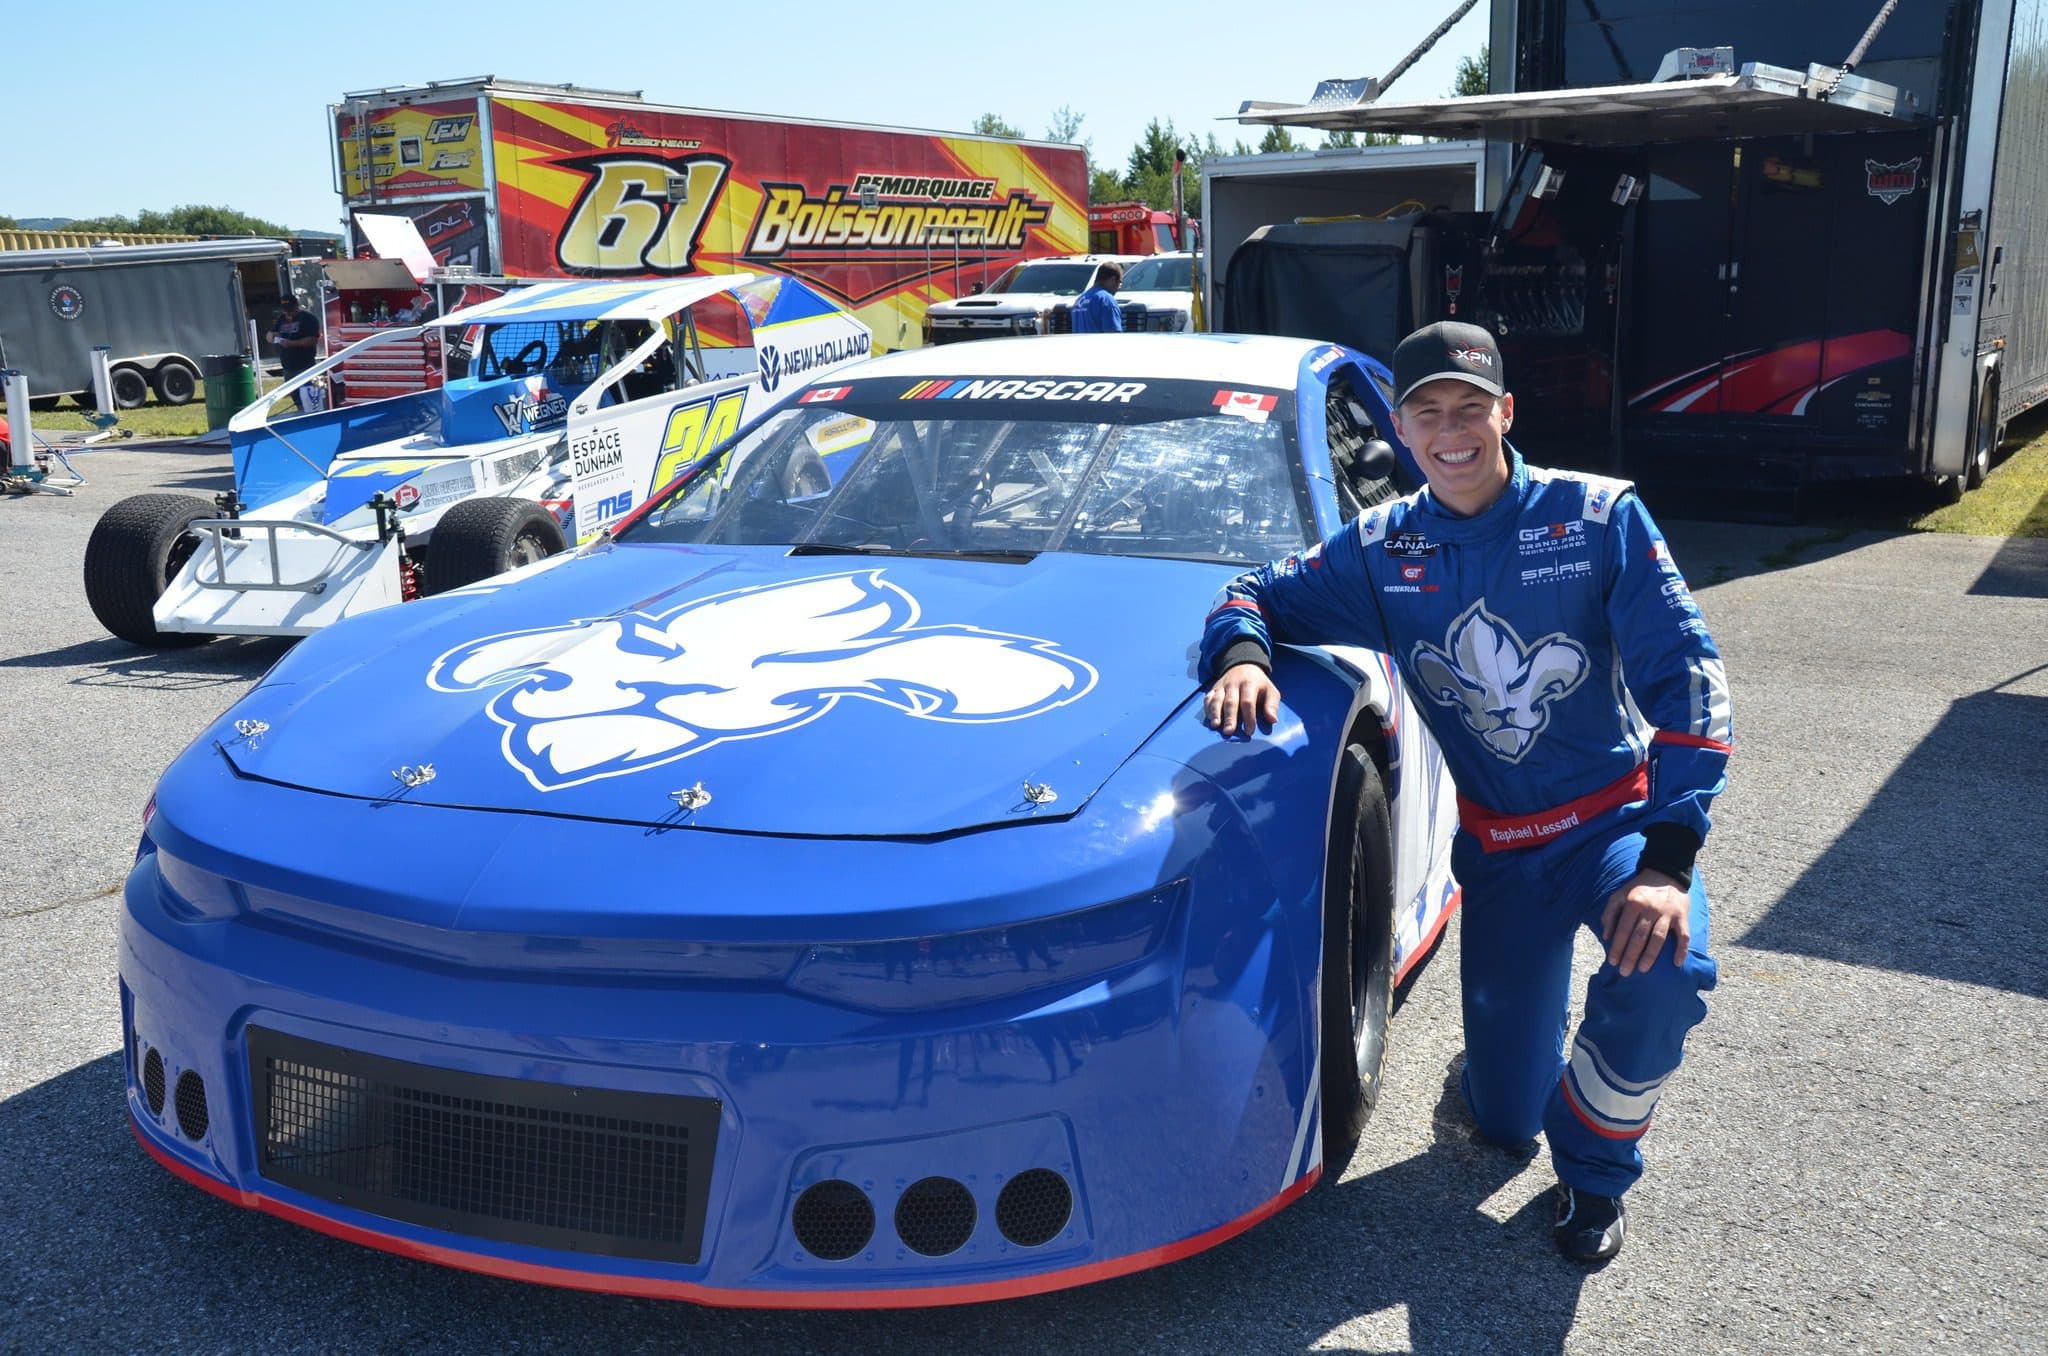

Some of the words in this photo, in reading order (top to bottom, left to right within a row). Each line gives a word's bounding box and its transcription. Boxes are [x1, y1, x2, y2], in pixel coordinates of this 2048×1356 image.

[560, 158, 728, 270] 61
[749, 186, 1046, 254] Boissonneault
[783, 349, 814, 377] NEW
[814, 332, 870, 365] HOLLAND
[1455, 349, 1492, 367] XPN
[953, 380, 1148, 403] NASCAR
[522, 398, 568, 423] WEGNER
[572, 432, 621, 460] ESPACE
[575, 448, 623, 477] DUNHAM
[1518, 538, 1559, 551] GRAND
[1560, 533, 1586, 545] PRIX
[1519, 519, 1585, 542] GP3R
[1521, 558, 1592, 581] SPIRE
[1534, 811, 1580, 837] Lessard
